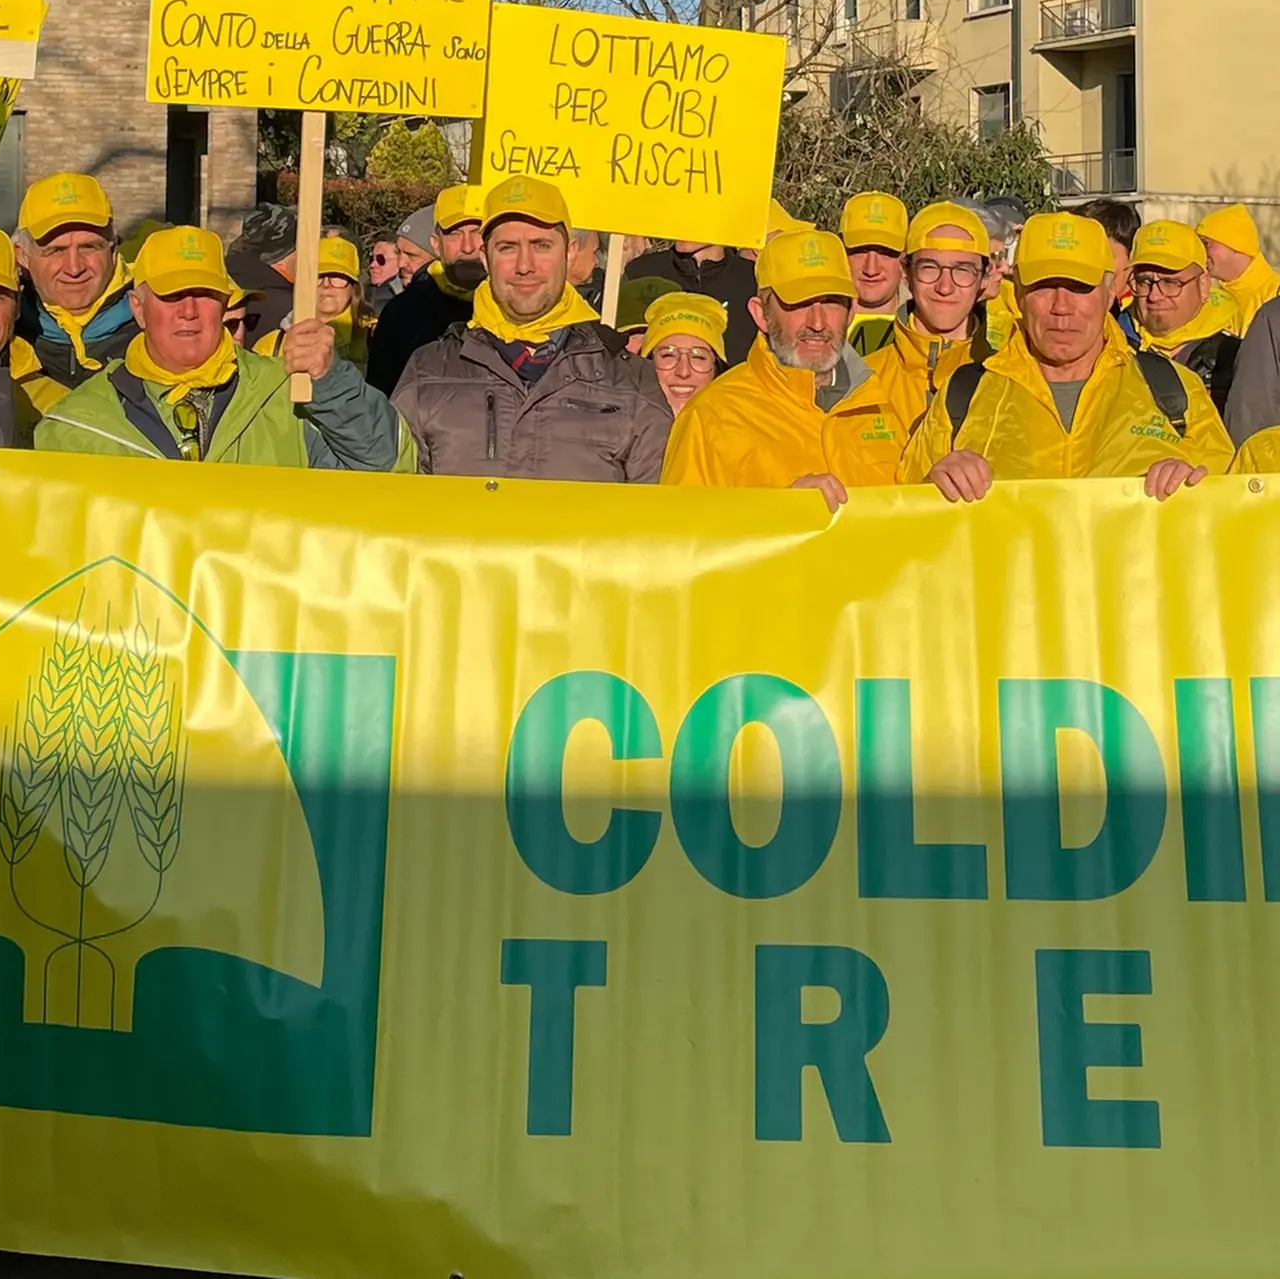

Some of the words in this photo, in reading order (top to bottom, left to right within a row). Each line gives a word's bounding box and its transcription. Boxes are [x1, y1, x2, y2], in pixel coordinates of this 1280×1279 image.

[160, 0, 256, 49] CONTO
[261, 31, 311, 50] DELLA
[331, 6, 431, 62] GUERRA
[549, 23, 729, 84] LOTTIAMO
[156, 56, 249, 99] SEMPRE
[298, 55, 437, 108] CONTADINI
[553, 82, 608, 127] PER
[640, 78, 717, 139] CIBI
[491, 129, 581, 177] SENZA
[607, 133, 723, 196] RISCHI
[659, 312, 712, 330] COLDIRETTI
